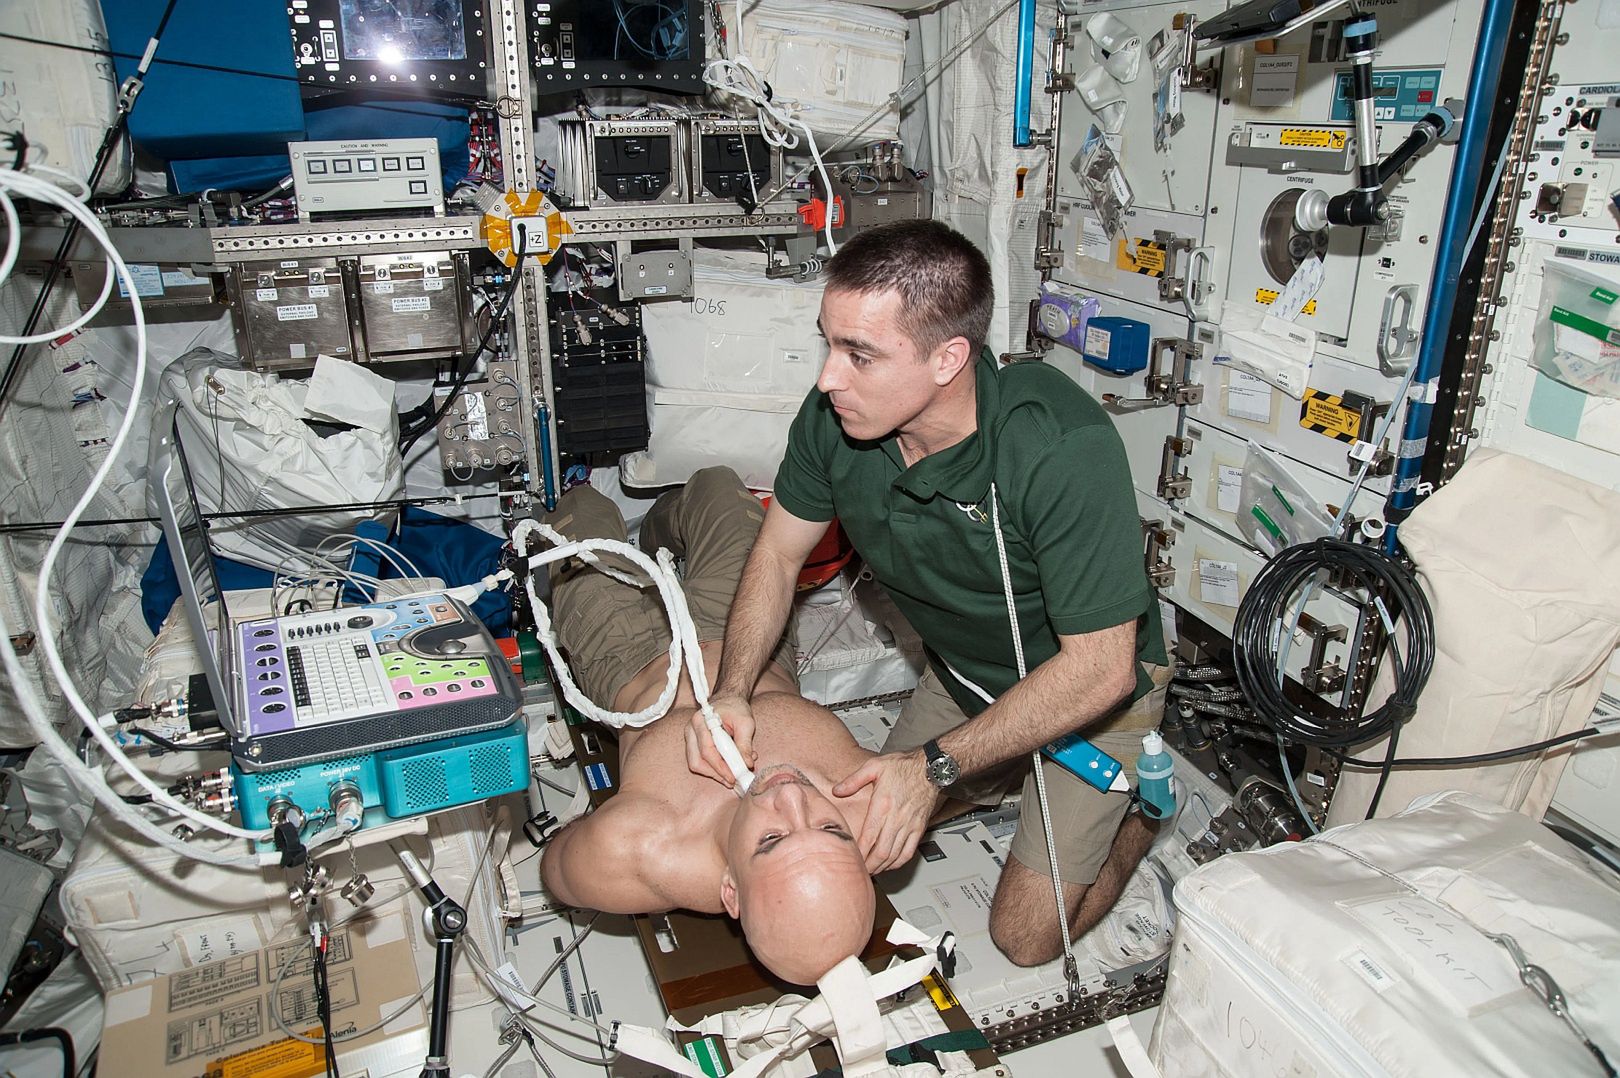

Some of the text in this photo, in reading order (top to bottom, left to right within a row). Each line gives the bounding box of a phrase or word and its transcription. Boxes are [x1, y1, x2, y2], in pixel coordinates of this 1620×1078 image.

[1579, 86, 1620, 95] CARDIOL
[1286, 175, 1315, 184] CENTRIFUGE
[531, 235, 542, 244] +Z
[689, 297, 727, 316] 1068
[1315, 402, 1340, 415] WARNING
[1398, 899, 1458, 935] COL
[1381, 908, 1493, 991] TOOL KIT
[561, 969, 572, 993] STOWAGE
[330, 1027, 357, 1039] Alenia
